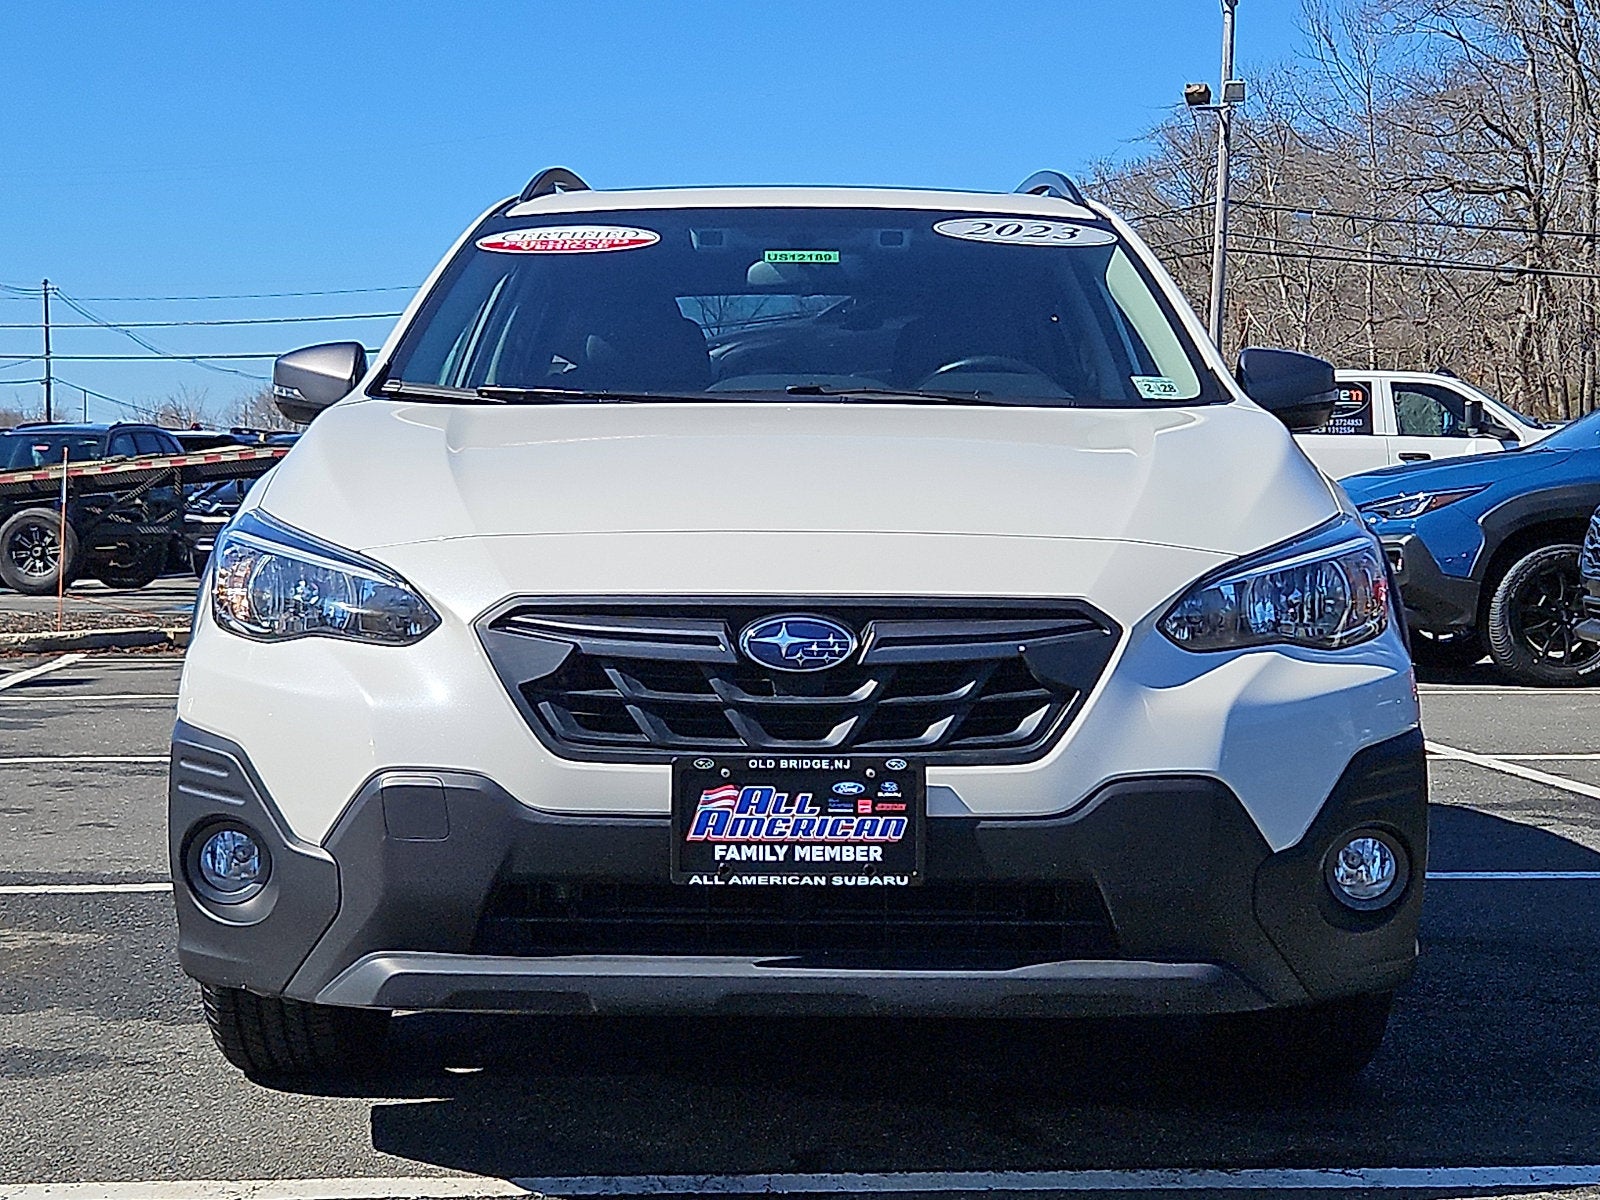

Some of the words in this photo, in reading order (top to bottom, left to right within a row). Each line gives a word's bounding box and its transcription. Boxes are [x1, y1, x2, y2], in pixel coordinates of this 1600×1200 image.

[503, 230, 640, 241] CERTIFIED
[964, 222, 1081, 240] 2023
[748, 759, 775, 769] OLD
[779, 759, 851, 770] BRIDGE,NJ
[735, 785, 821, 817] ALL
[686, 808, 909, 842] AMERICAN
[714, 844, 789, 862] FAMILY
[794, 844, 883, 862] MEMBER
[688, 875, 726, 885] ALL
[728, 875, 827, 886] AMERICAN
[830, 875, 909, 886] SUBARU
